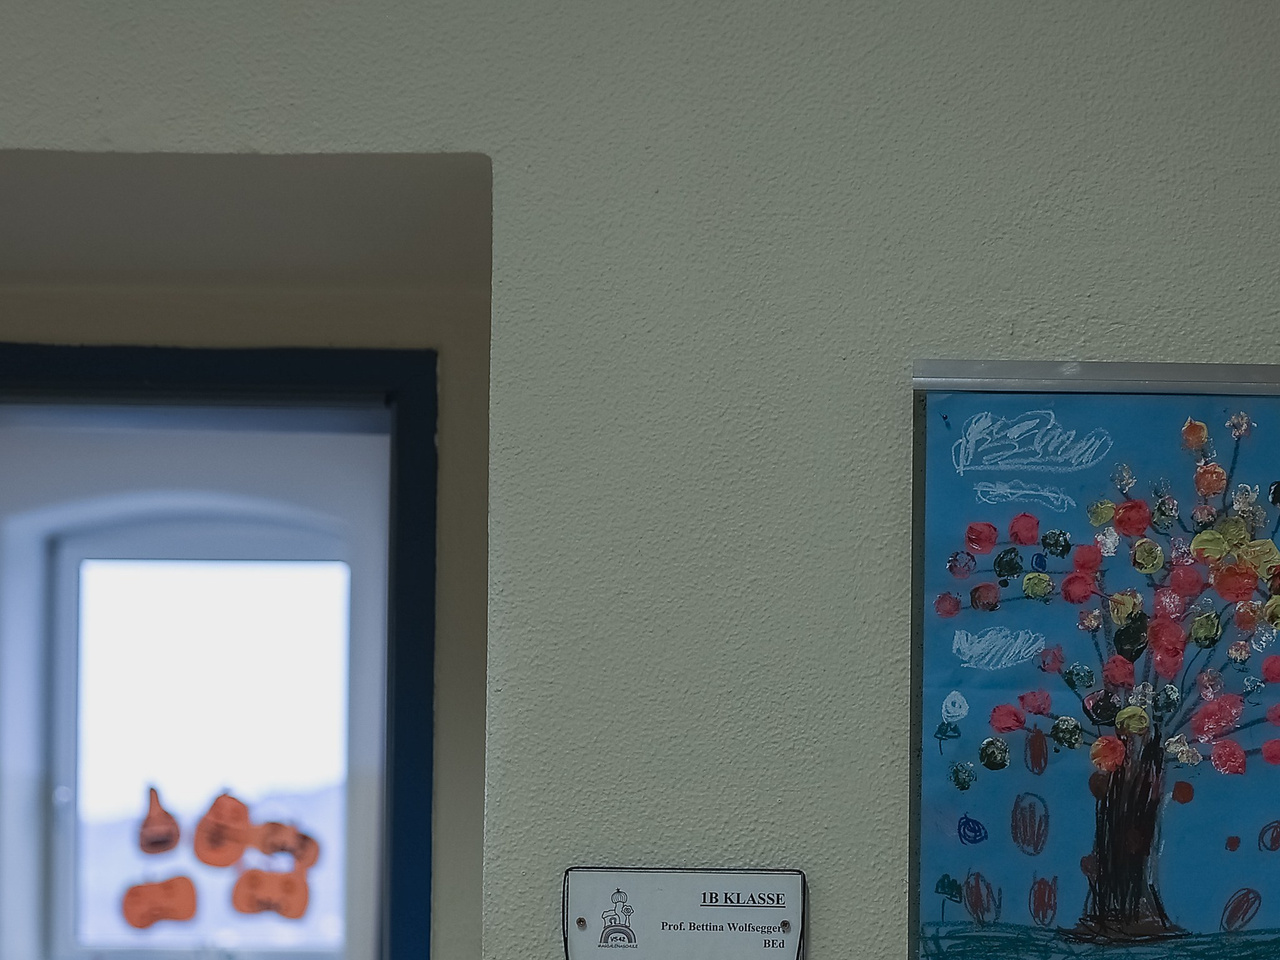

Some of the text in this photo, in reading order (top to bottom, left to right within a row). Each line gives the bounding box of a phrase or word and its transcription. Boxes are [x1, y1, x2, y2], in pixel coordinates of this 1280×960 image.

[701, 892, 786, 905] 1B KLASSE
[661, 921, 686, 931] Prof.
[689, 922, 724, 932] Bettina
[763, 939, 785, 949] BEd
